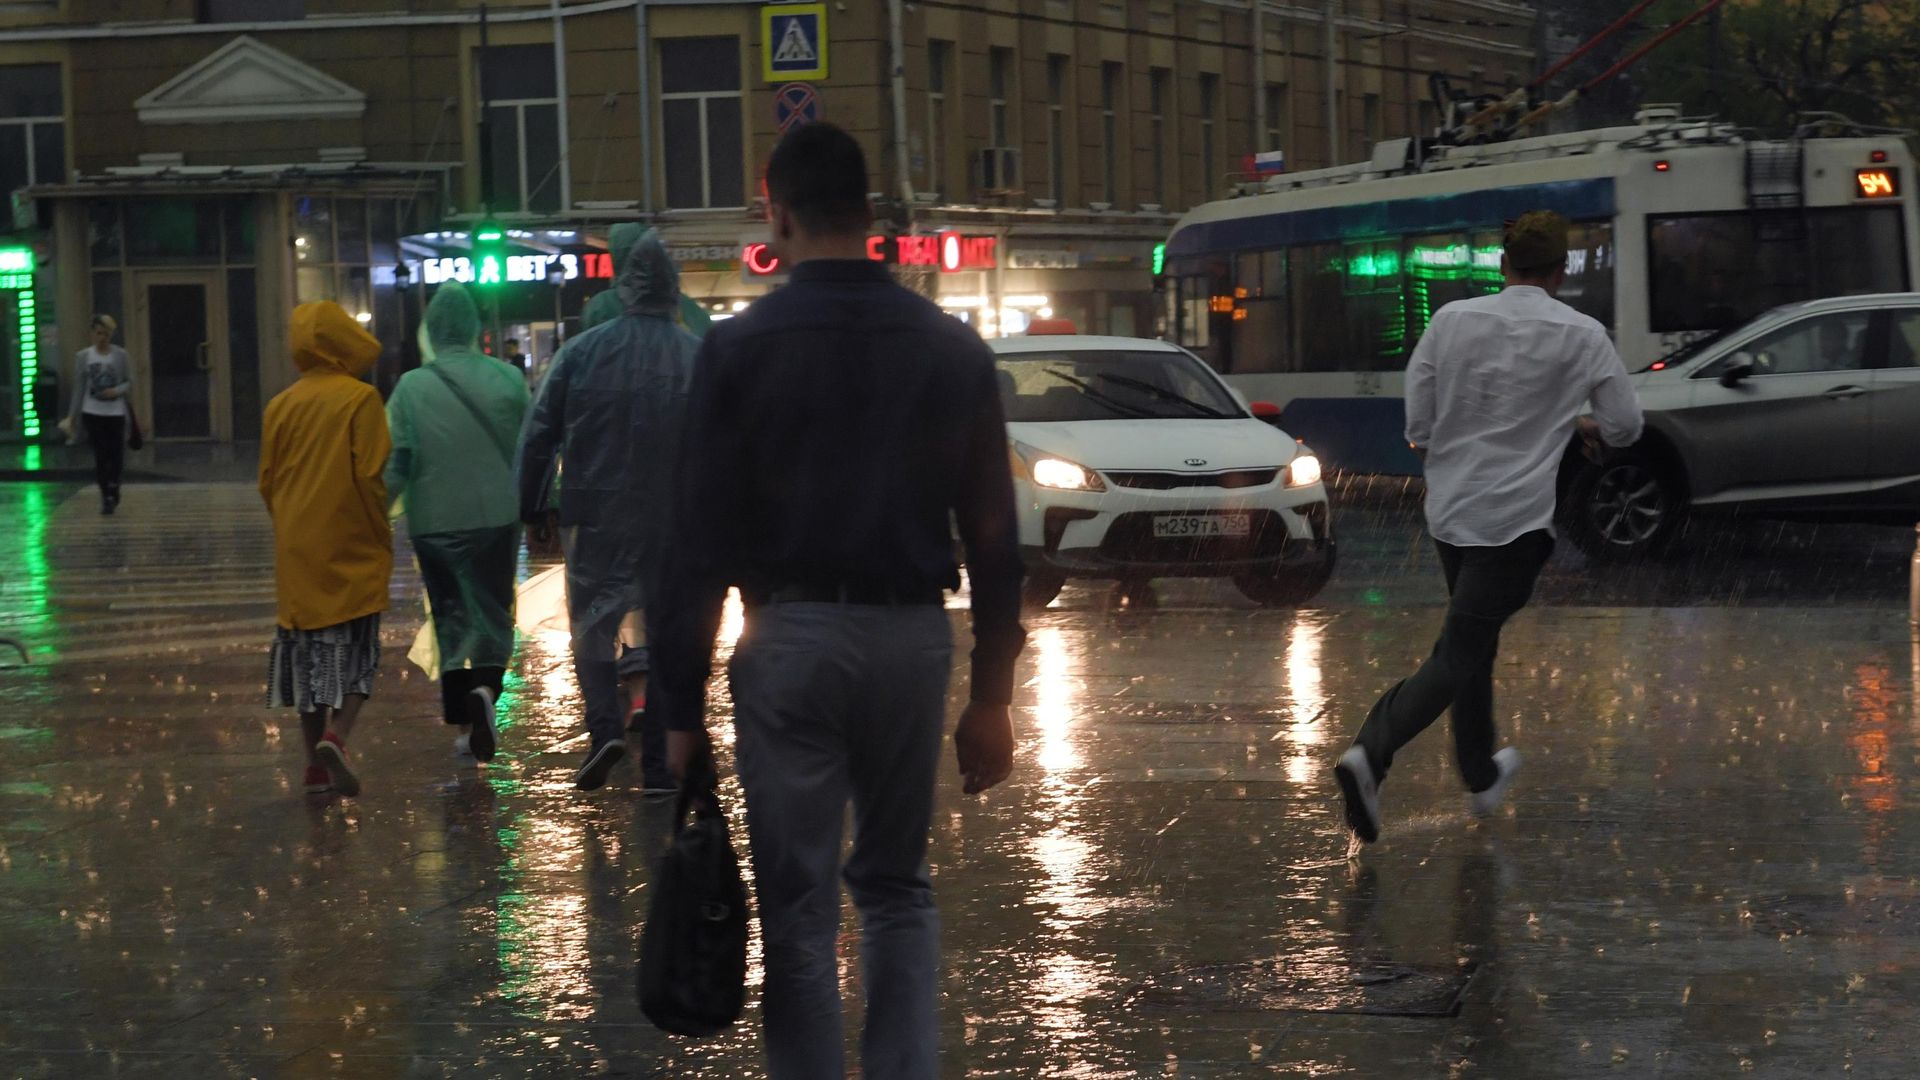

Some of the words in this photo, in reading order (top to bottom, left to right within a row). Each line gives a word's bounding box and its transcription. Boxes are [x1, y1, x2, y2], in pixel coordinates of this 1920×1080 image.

[1857, 173, 1893, 194] 54
[583, 253, 614, 278] ТА
[1157, 518, 1220, 535] М239ТА
[1222, 515, 1247, 529] 750
